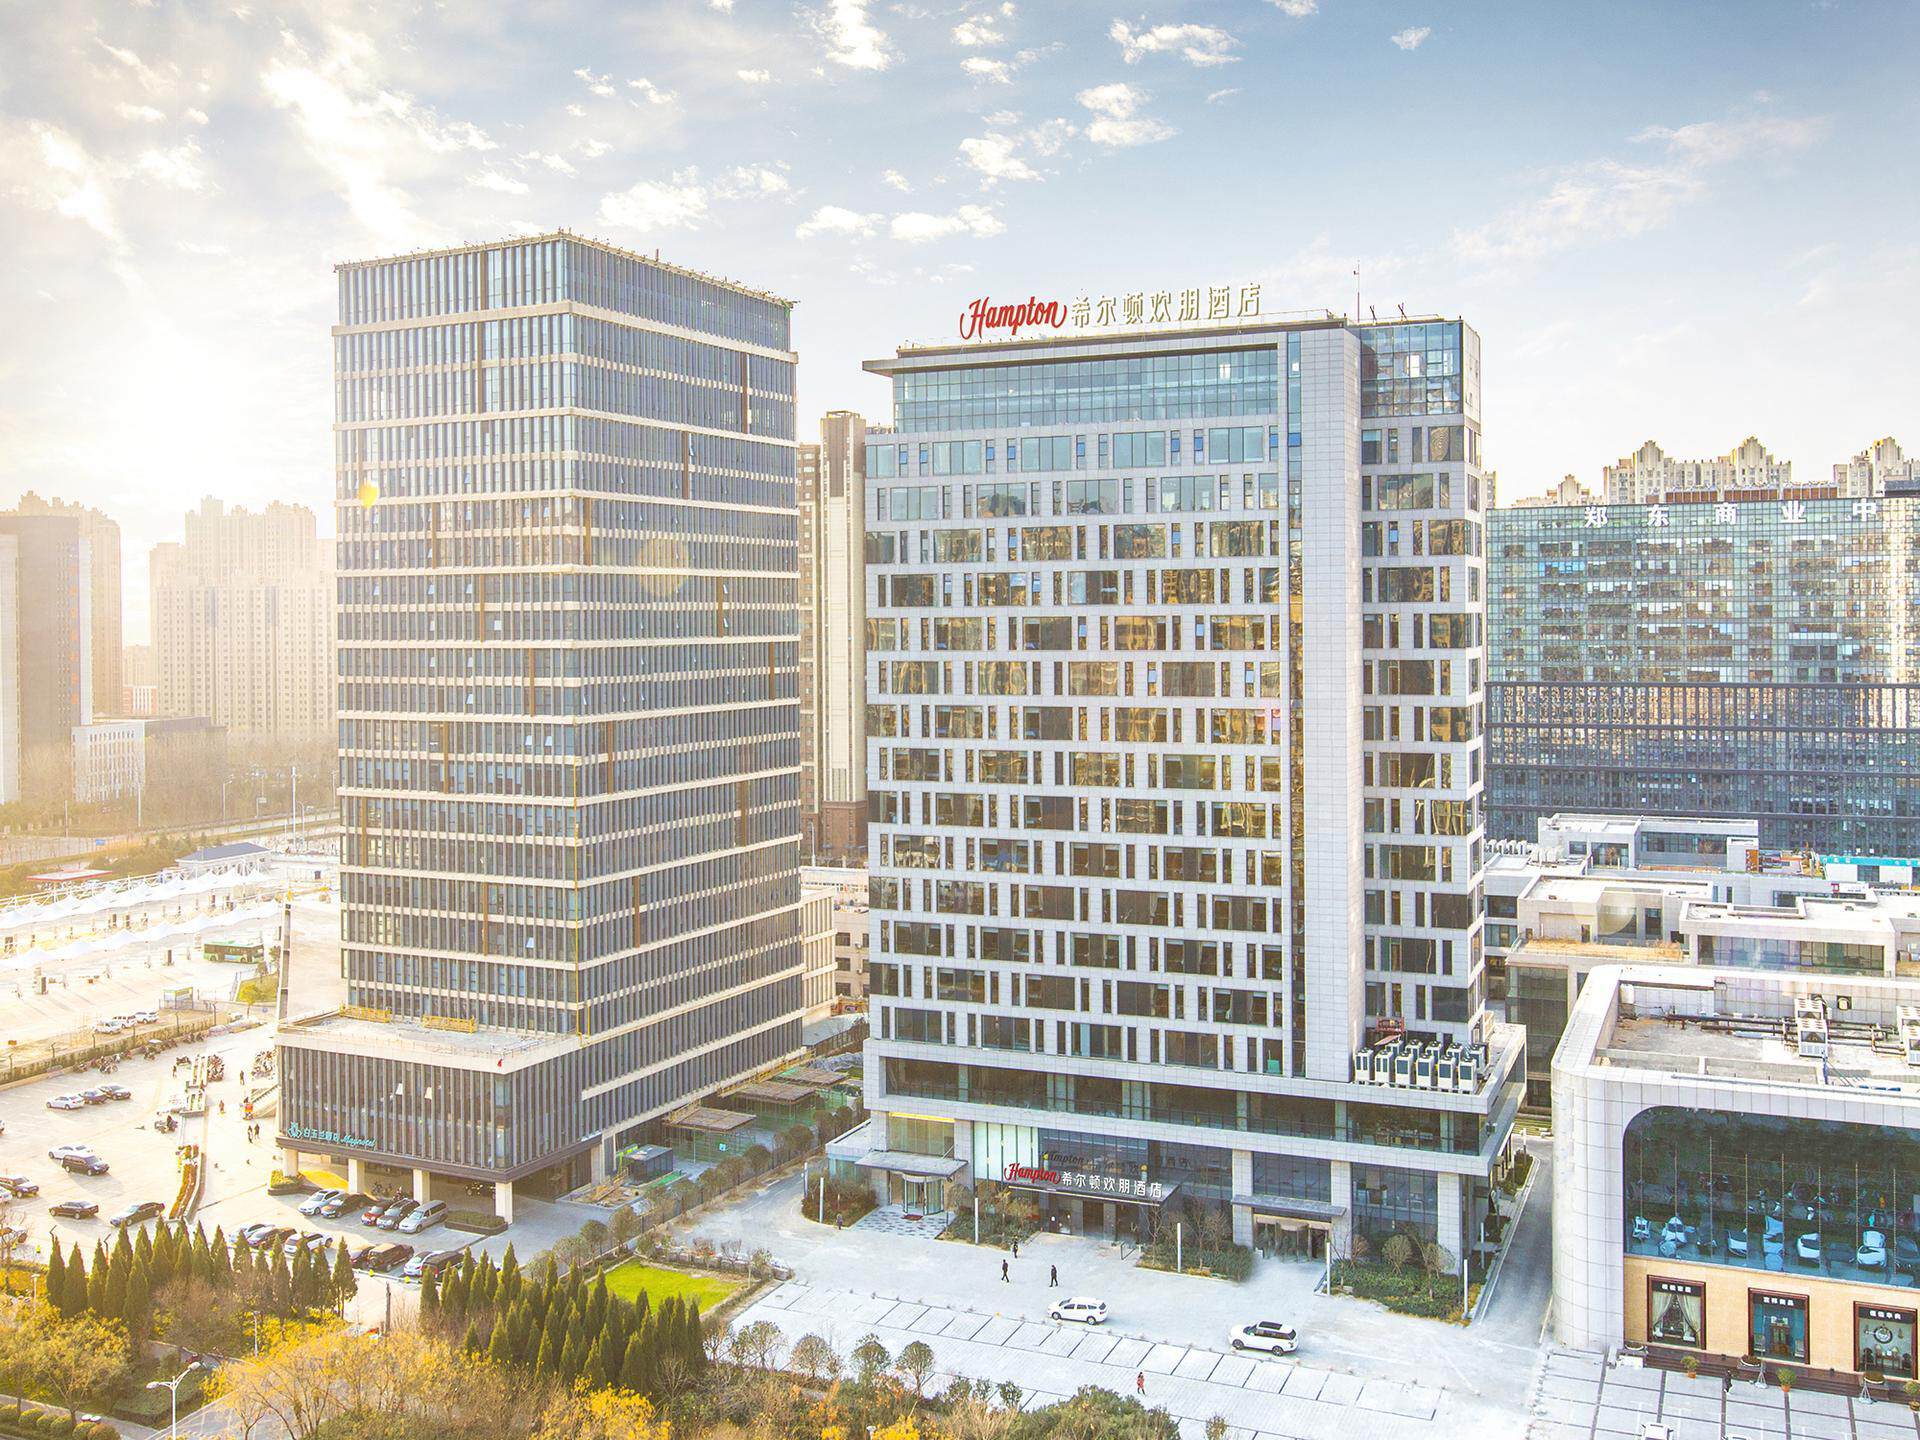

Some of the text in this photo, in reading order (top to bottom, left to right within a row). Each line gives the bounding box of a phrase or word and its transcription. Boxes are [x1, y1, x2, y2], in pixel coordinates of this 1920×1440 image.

[959, 283, 1261, 340] Hampton 希尔顿欢朋酒店
[1583, 498, 1878, 528] 郑东商业中
[1003, 1162, 1062, 1185] Hampton
[1061, 1171, 1163, 1198] 希尔顿欢朋酒店
